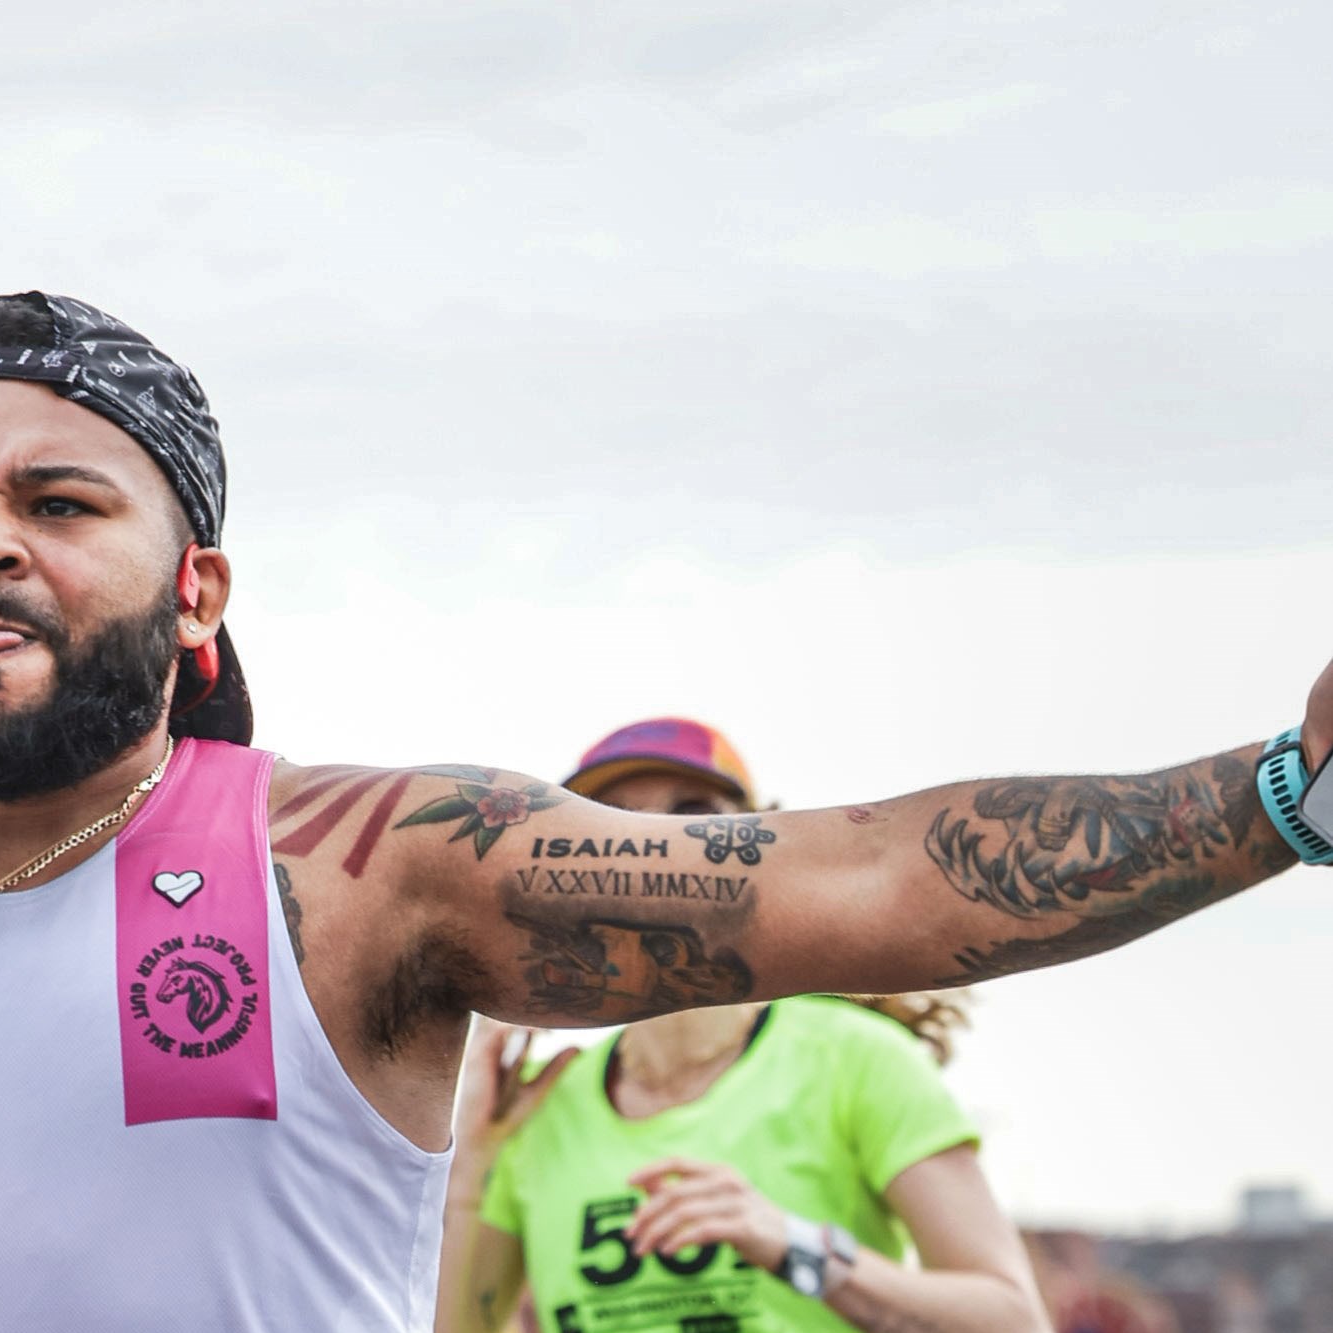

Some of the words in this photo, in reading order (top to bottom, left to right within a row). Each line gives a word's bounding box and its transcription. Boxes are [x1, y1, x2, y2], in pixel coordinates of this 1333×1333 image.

[531, 838, 669, 859] ISAIAH
[517, 866, 539, 895] V
[546, 869, 631, 897] XXVII
[641, 872, 748, 902] MMXIV
[136, 936, 184, 979] NEVER
[191, 934, 257, 987] PROJECT
[129, 982, 150, 1020] QUIT
[143, 1022, 177, 1054] THE
[179, 992, 259, 1059] MEANINGFUL
